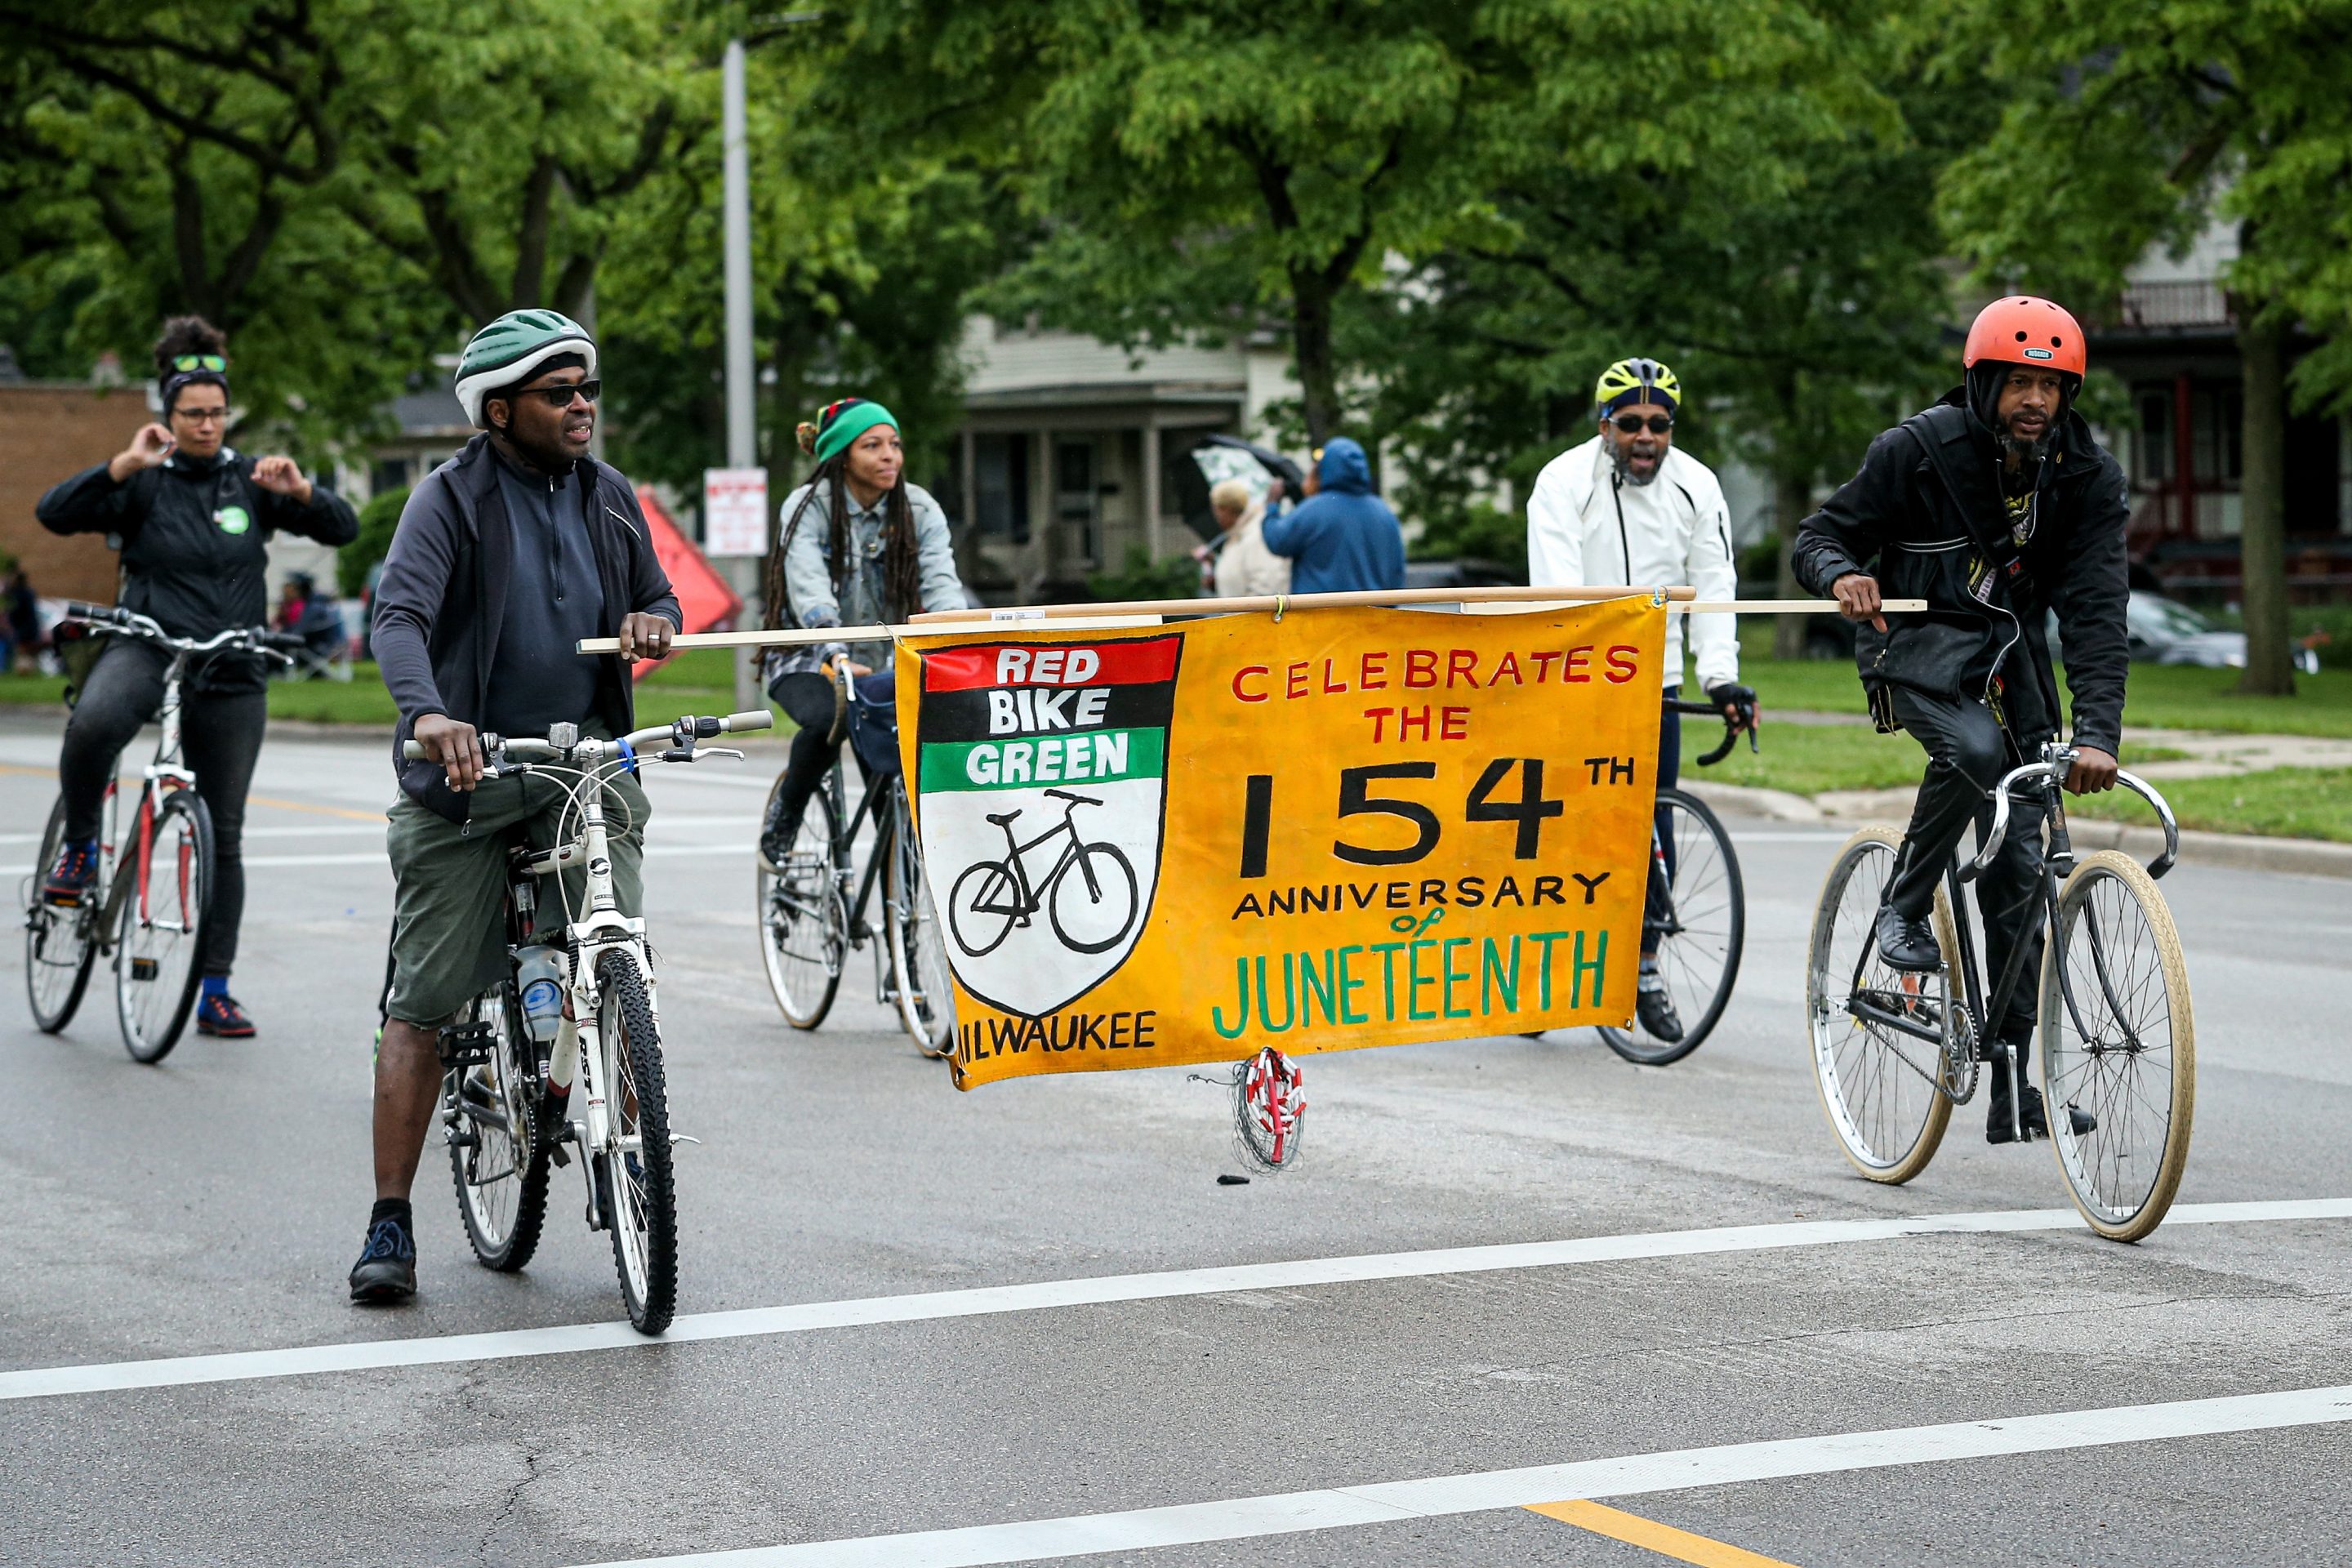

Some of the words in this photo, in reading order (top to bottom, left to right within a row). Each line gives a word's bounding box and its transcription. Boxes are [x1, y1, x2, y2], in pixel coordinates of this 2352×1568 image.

[997, 648, 1100, 684] RED
[1232, 644, 1639, 702] CELEBRATES
[988, 688, 1111, 734] BIKE
[1365, 706, 1470, 743] THE
[966, 733, 1129, 786] GREEN
[1232, 872, 1610, 920] ANNIVERSARY
[1391, 907, 1445, 937] of
[1213, 930, 1607, 1039] JUNETEENTH
